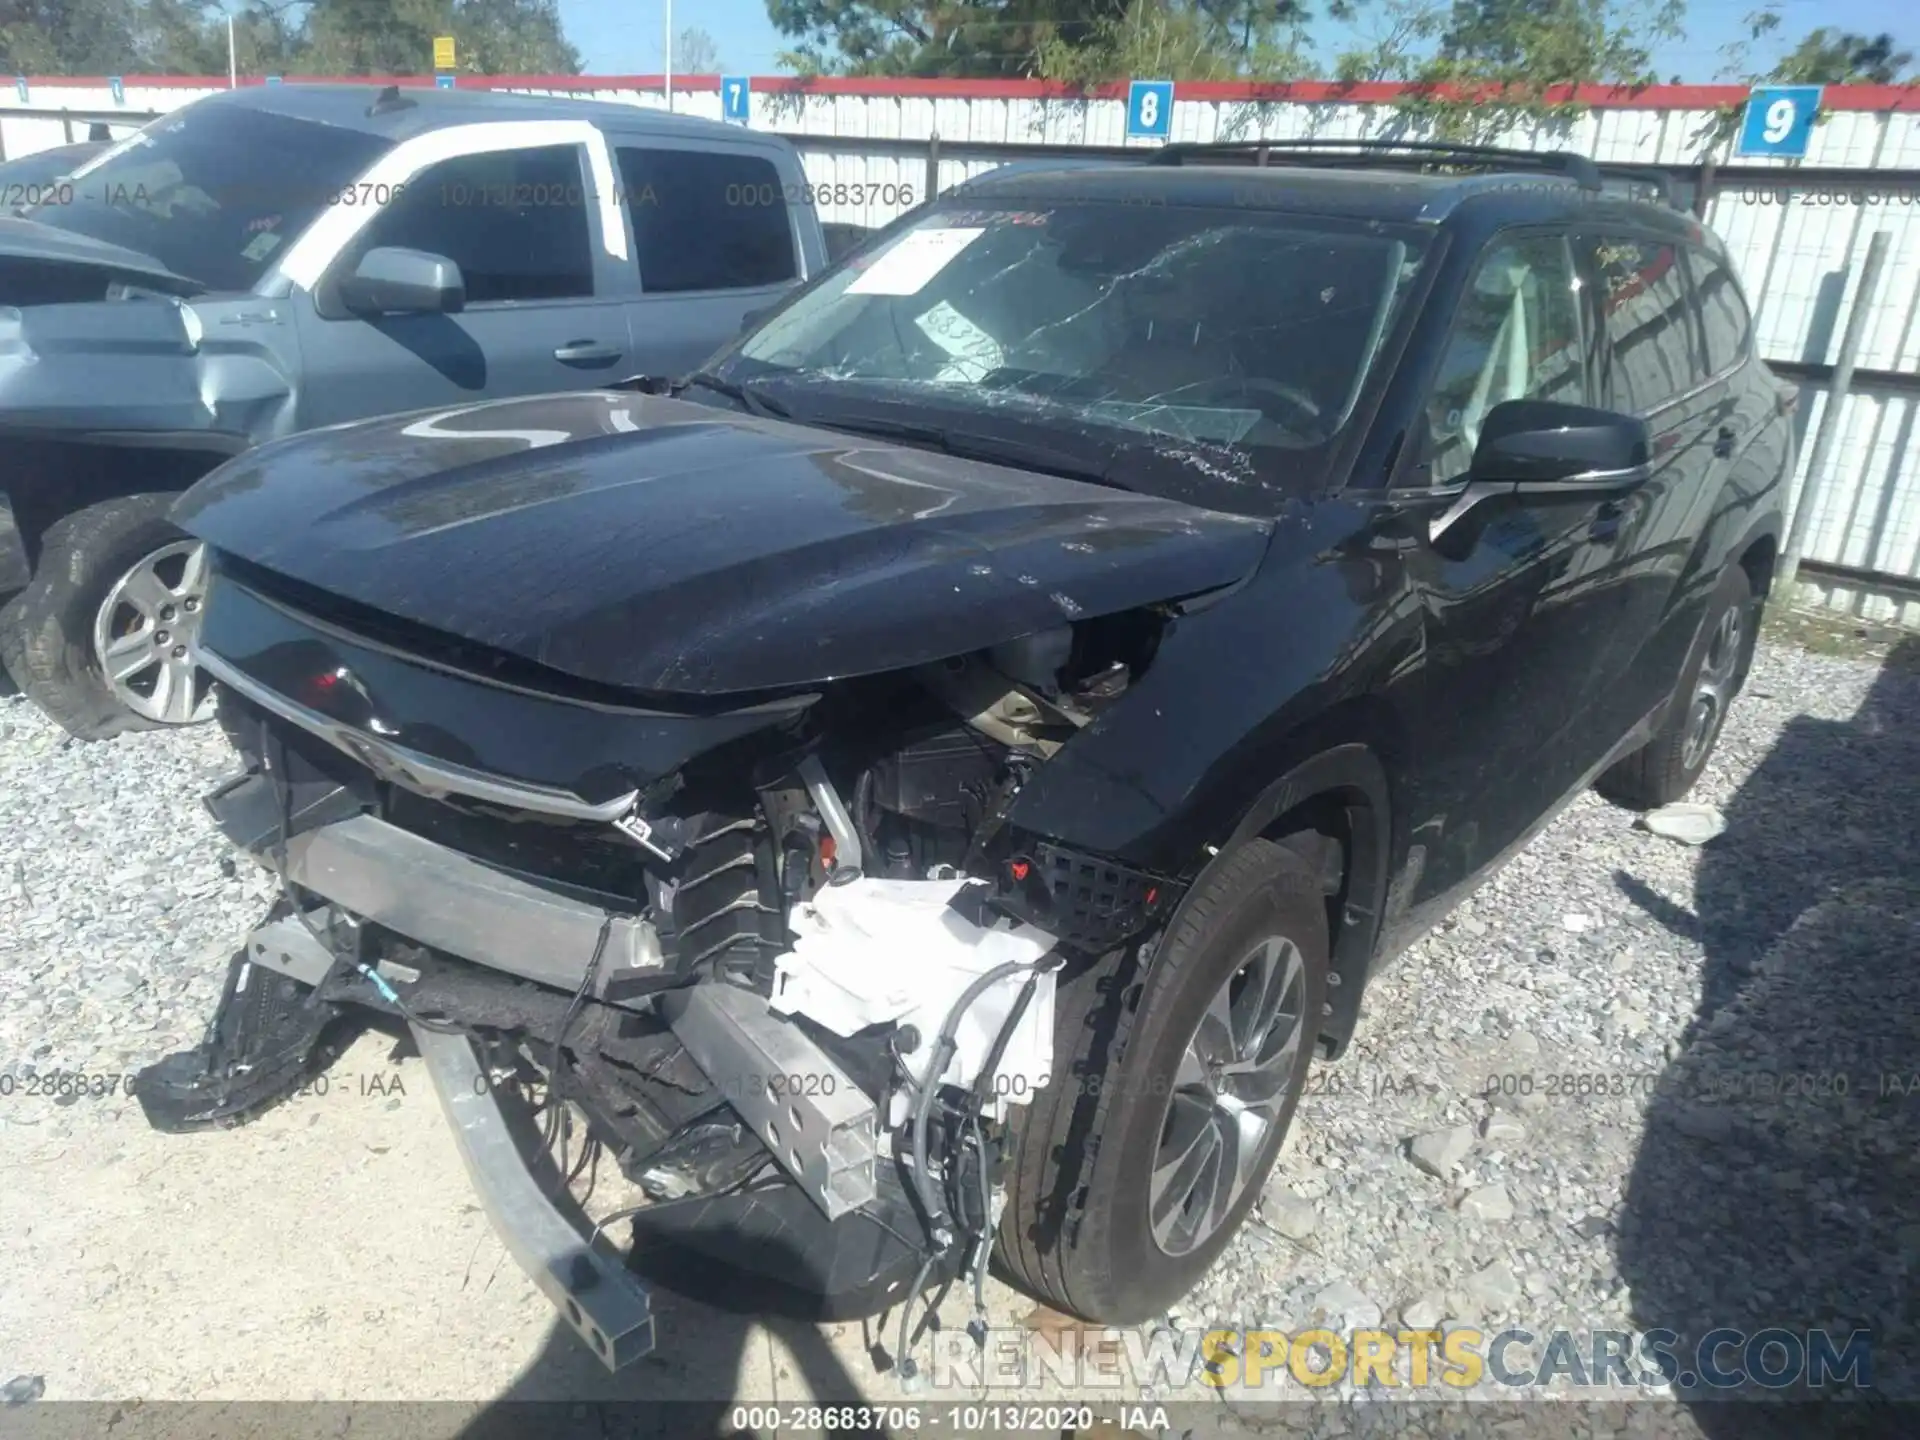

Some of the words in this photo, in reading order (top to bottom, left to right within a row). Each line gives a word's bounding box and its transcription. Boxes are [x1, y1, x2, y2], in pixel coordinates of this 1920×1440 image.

[729, 83, 741, 112] 7
[1140, 91, 1159, 128] 8
[1763, 99, 1795, 143] 9
